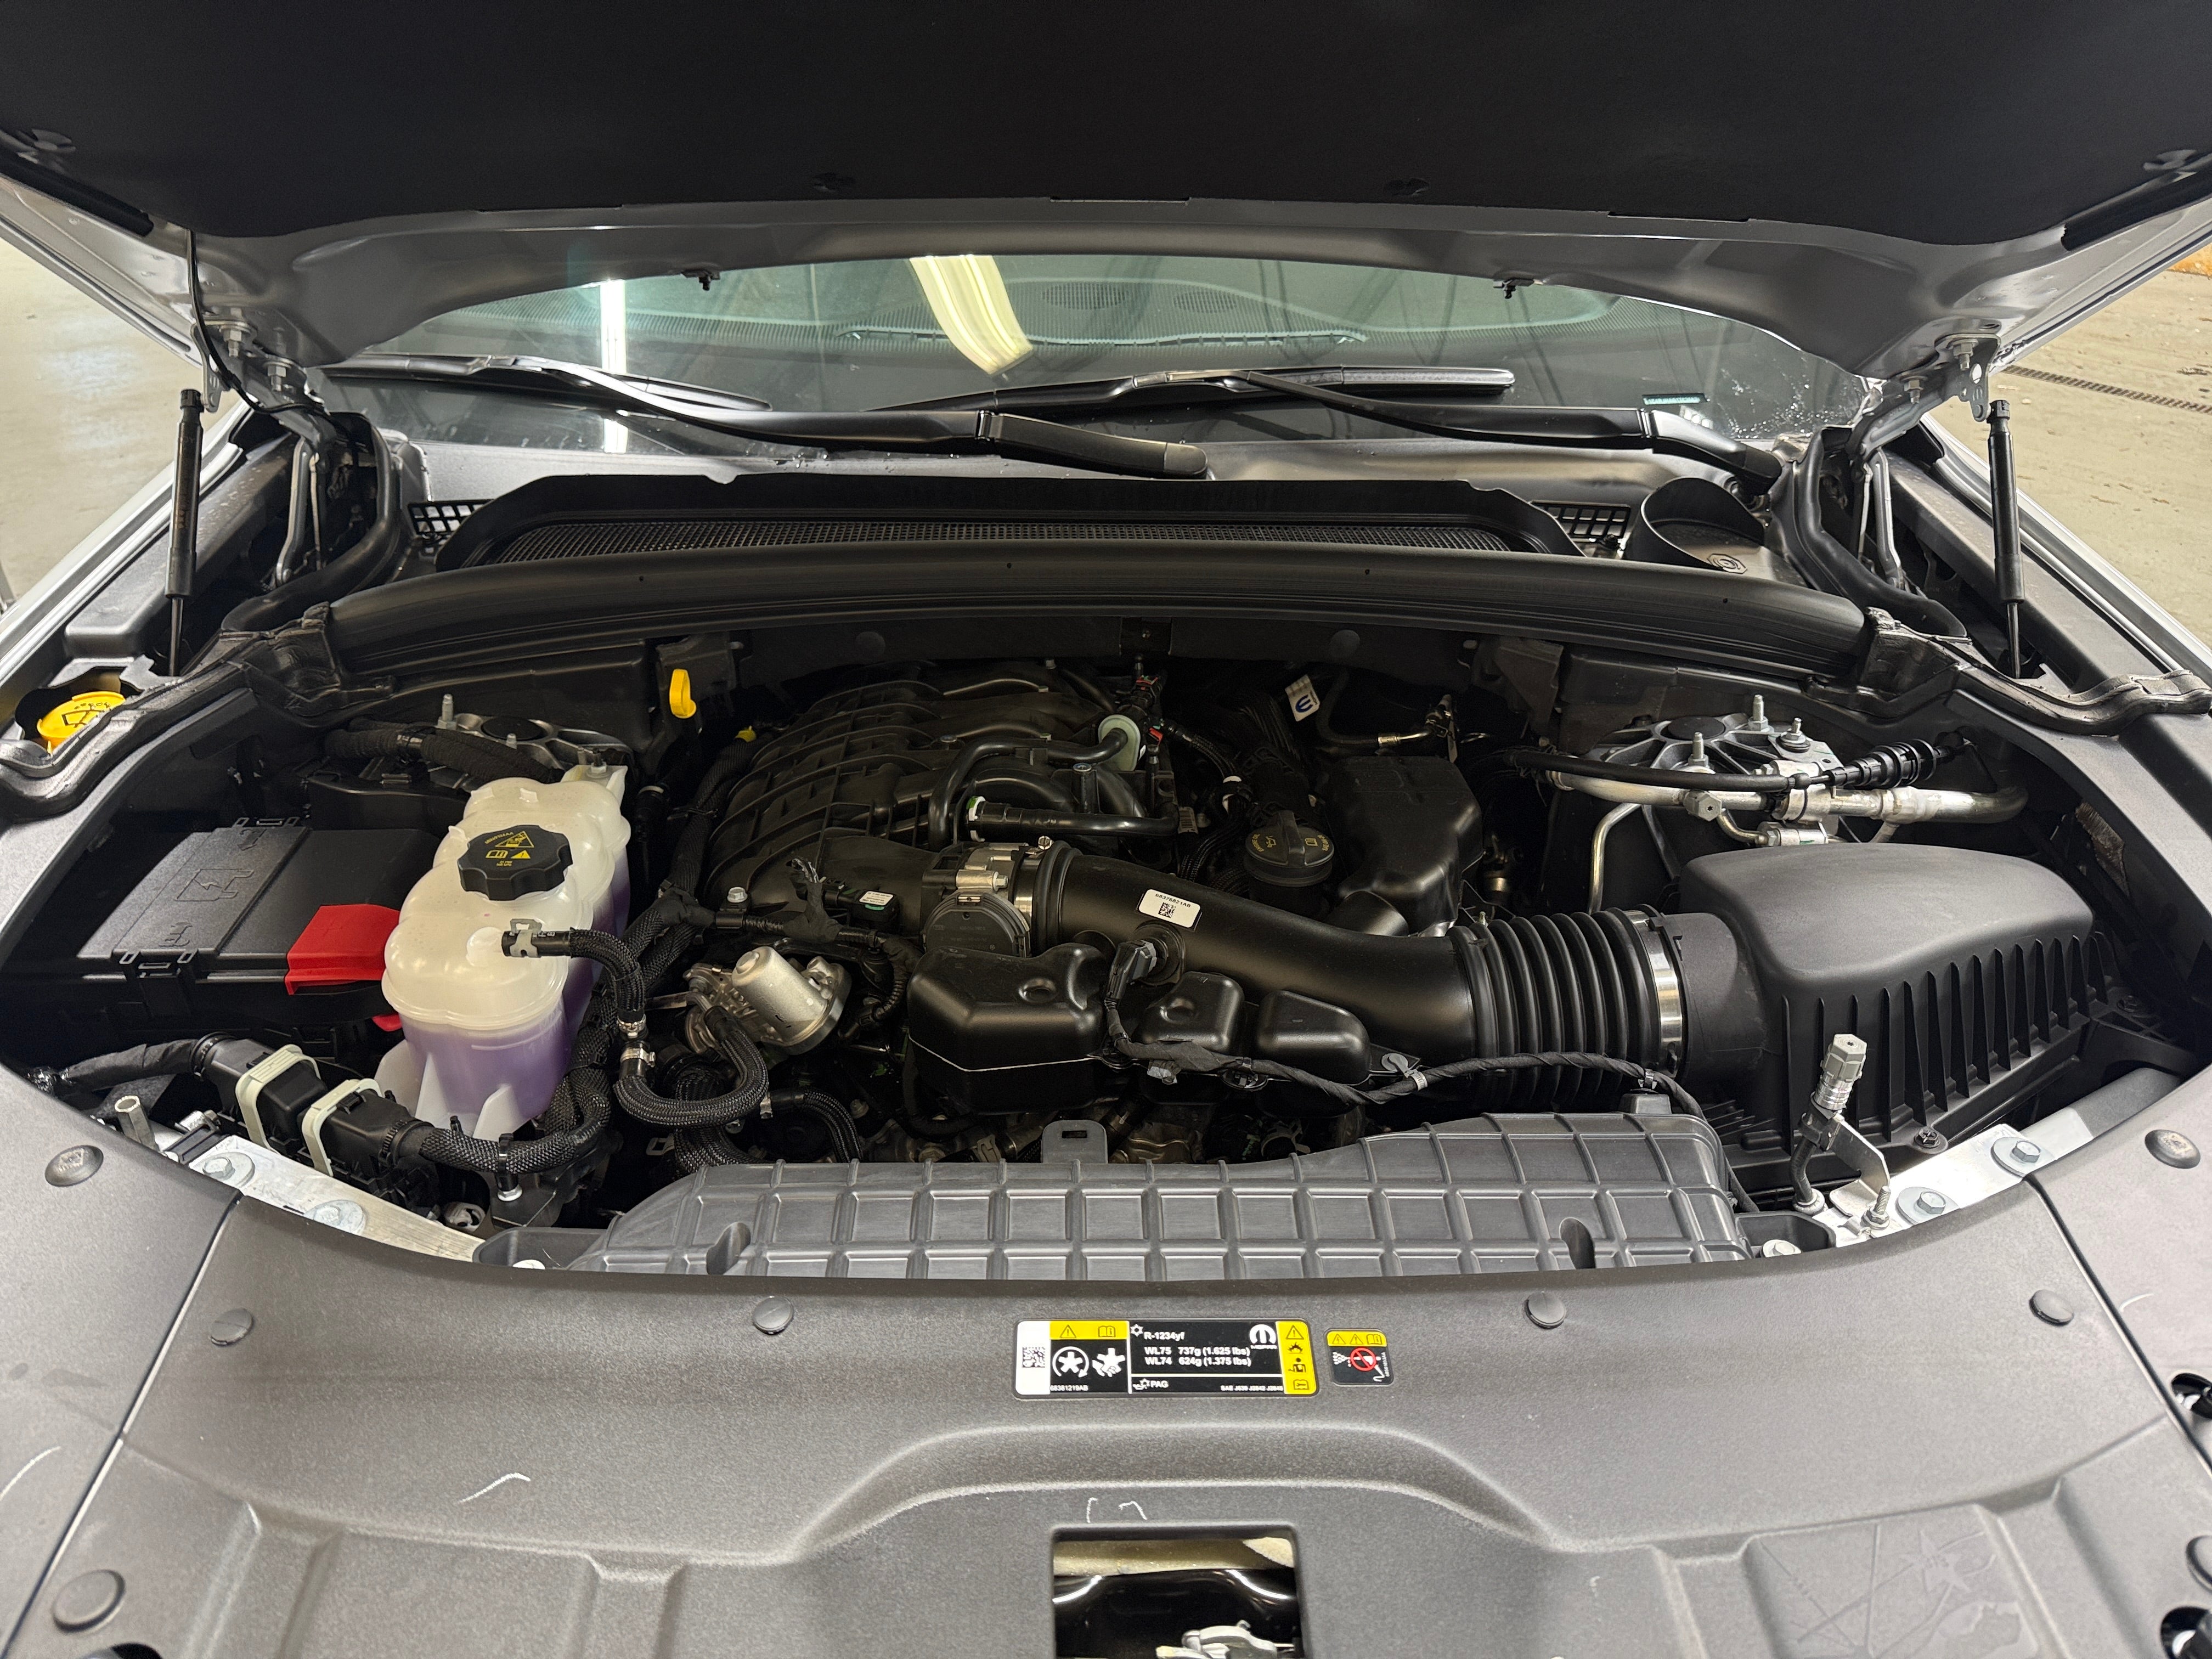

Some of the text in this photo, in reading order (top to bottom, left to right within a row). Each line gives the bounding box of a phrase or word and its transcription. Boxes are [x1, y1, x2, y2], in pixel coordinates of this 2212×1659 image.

[1144, 1331, 1185, 1342] R-1234yf
[1144, 1346, 1251, 1357] WL75 737g (1.625 lbs)
[1145, 1356, 1252, 1367] WL74 624g (1.375 lbs)
[1151, 1380, 1169, 1389] PAG
